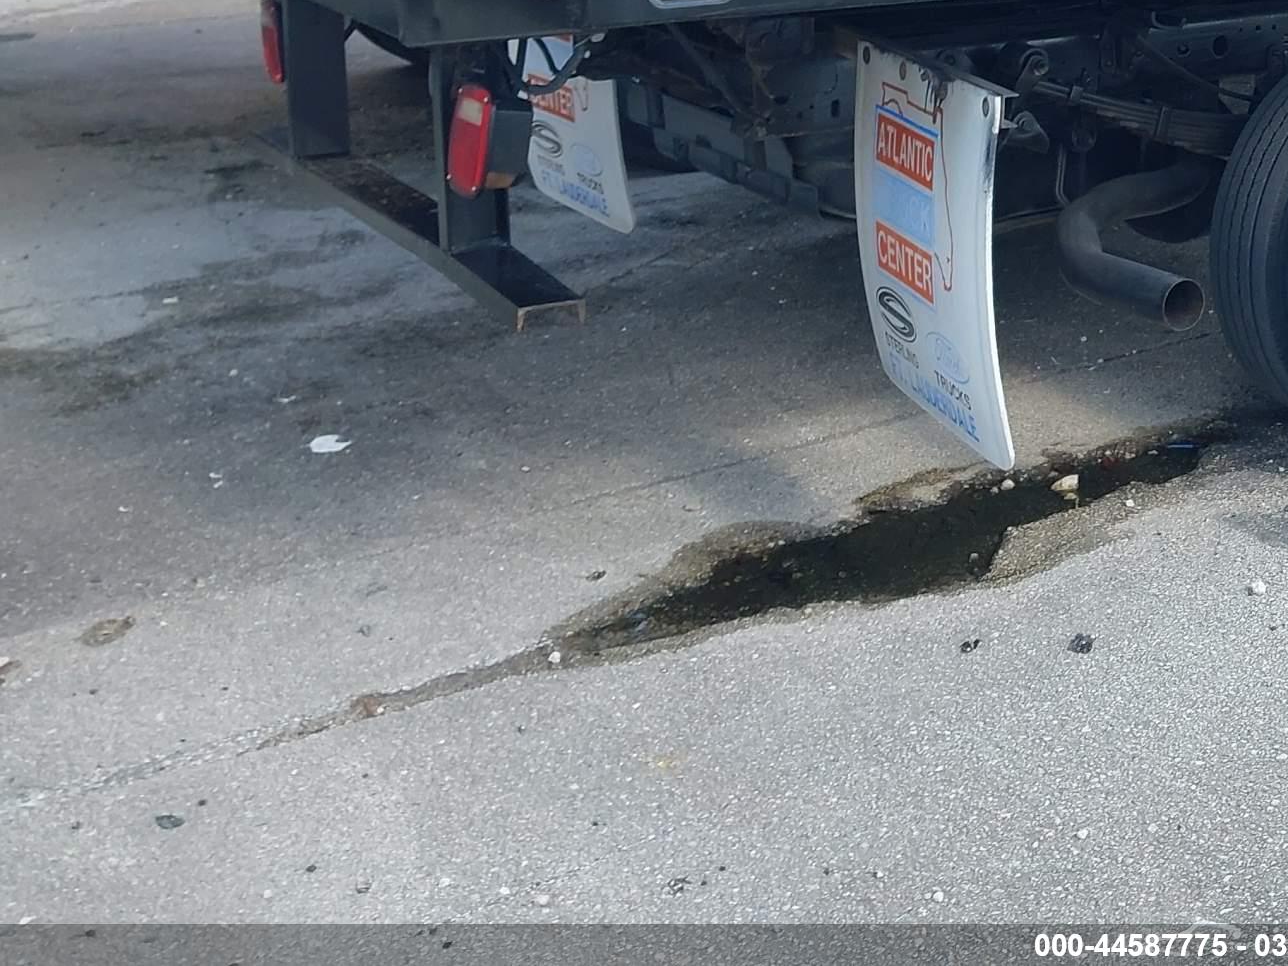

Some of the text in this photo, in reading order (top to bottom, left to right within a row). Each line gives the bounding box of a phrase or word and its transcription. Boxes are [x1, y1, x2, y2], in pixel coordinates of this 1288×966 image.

[878, 120, 933, 182] ATLANTIC
[878, 230, 932, 295] CENTER
[934, 370, 972, 411] TRUCKS
